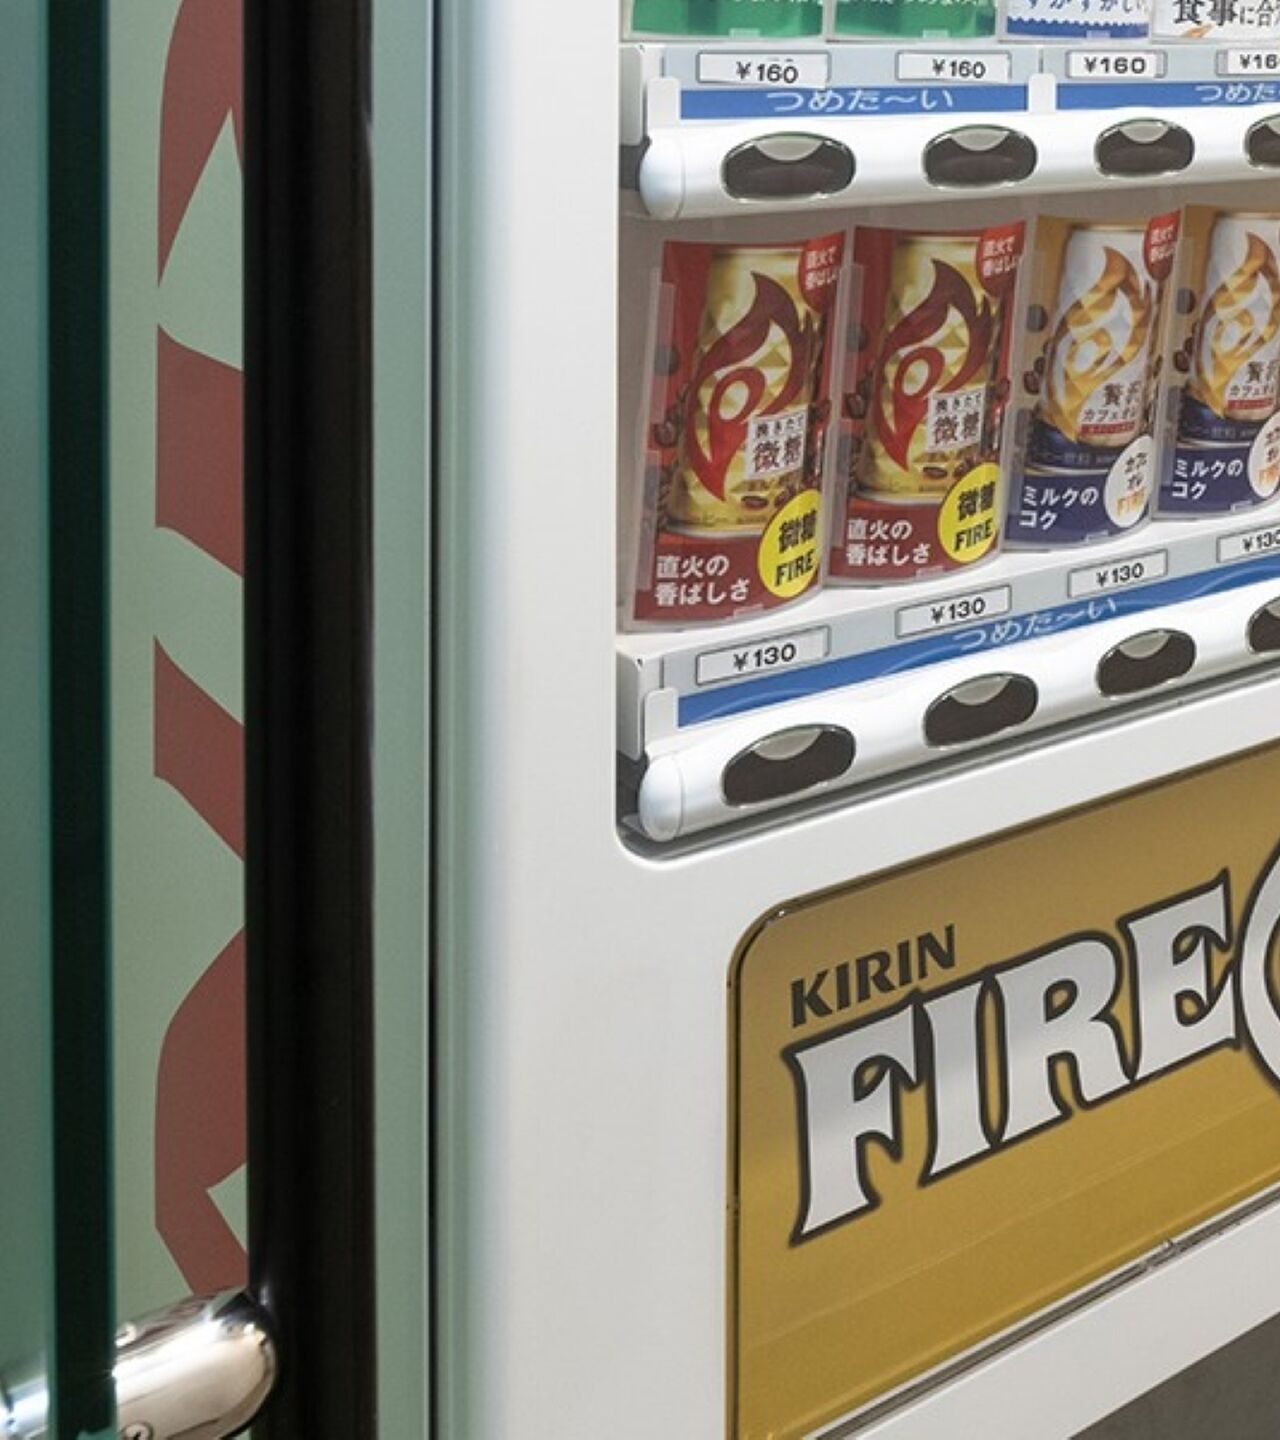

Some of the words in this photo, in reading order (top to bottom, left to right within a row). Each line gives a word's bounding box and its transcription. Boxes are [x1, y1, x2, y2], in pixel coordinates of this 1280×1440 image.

[735, 60, 799, 85] ¥160
[931, 59, 986, 79] ¥160
[1084, 56, 1146, 75] ¥160
[1174, 458, 1244, 480] ミルクの
[957, 478, 998, 519] 微糖
[1022, 483, 1100, 511] ミルクの
[1172, 480, 1208, 501] コク
[846, 517, 914, 541] 直火の
[1018, 508, 1057, 532] コク
[953, 519, 995, 555] FIRE
[846, 538, 932, 568] 香ばしさ
[655, 554, 730, 581] 直火の
[773, 546, 816, 588] FIRE
[1096, 562, 1145, 588] ¥130
[653, 577, 751, 607] 香ばしさ
[929, 597, 987, 625] ¥130
[732, 644, 797, 670] ¥130
[788, 921, 957, 1027] KIRIN
[785, 870, 1242, 1246] FIRE
